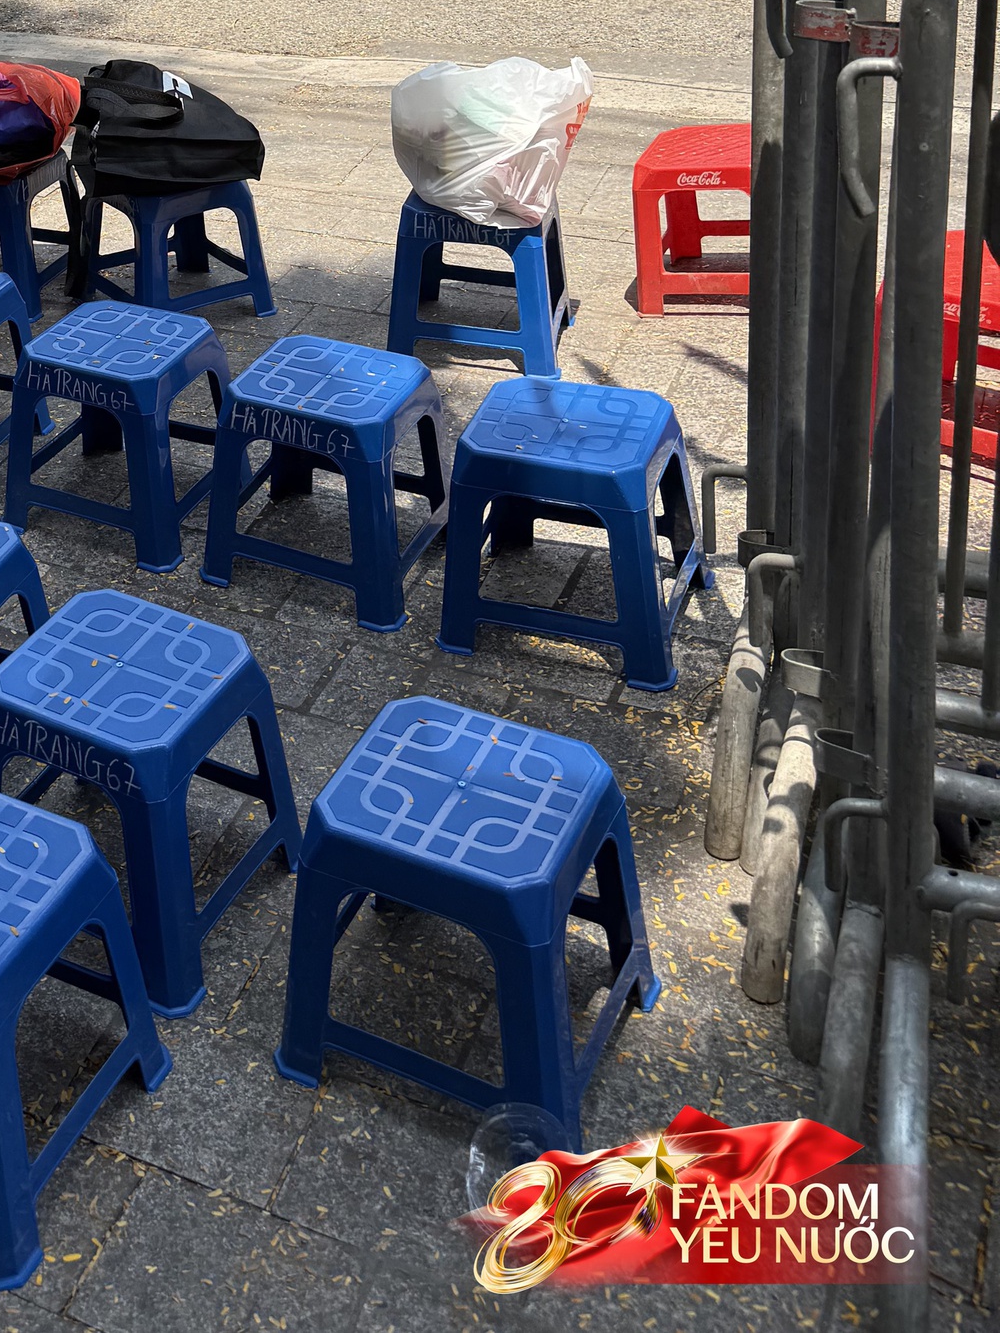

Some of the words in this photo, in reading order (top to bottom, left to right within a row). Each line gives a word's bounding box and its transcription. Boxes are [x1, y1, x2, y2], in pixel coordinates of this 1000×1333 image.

[677, 170, 722, 187] Coca-Cola
[26, 360, 51, 392] HÀ
[53, 368, 107, 406] TRANG
[110, 390, 135, 412] 67
[230, 401, 257, 435] HÀ
[261, 408, 324, 449] TRANG
[326, 428, 356, 458] 67
[24, 720, 105, 781] TRANG
[106, 758, 142, 796] 67
